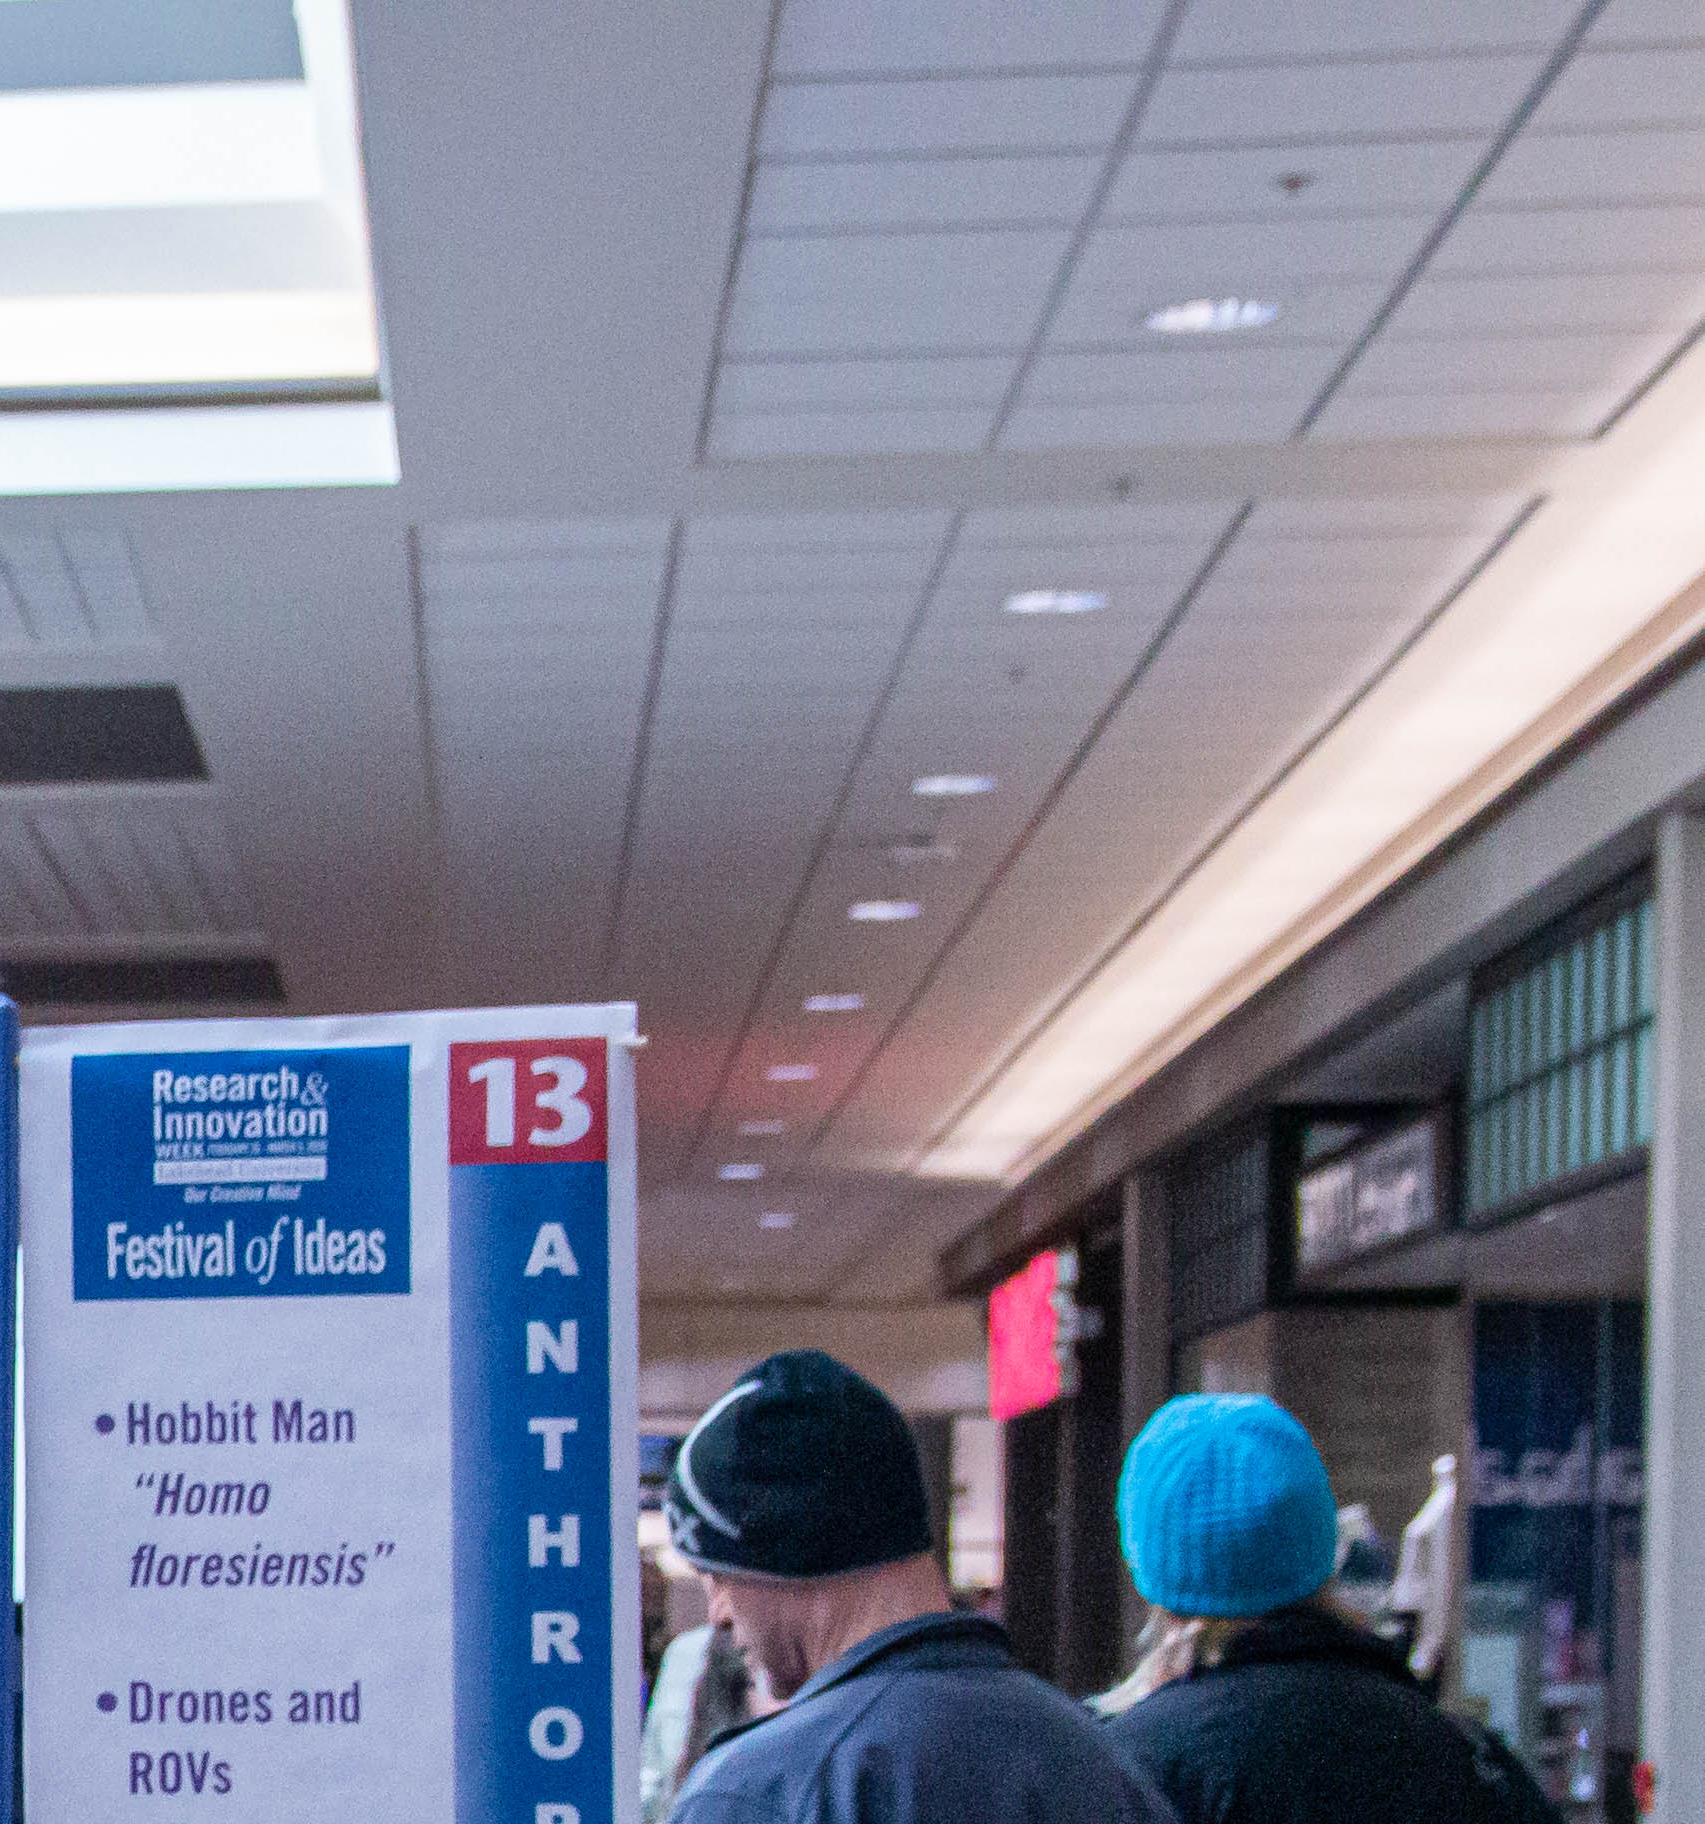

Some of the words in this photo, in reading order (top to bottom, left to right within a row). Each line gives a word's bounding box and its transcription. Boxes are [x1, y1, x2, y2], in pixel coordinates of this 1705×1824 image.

[153, 1066, 299, 1104] Research
[299, 1072, 329, 1107] &
[468, 1056, 592, 1147] 13
[153, 1101, 328, 1140] Innovation
[107, 1220, 234, 1279] Festival
[244, 1216, 290, 1285] of
[294, 1222, 387, 1275] Ideas
[127, 1402, 257, 1445] Hobbit
[273, 1399, 355, 1443] Man
[129, 1681, 273, 1724] Drones
[288, 1681, 361, 1724] and
[129, 1750, 232, 1795] ROVs
